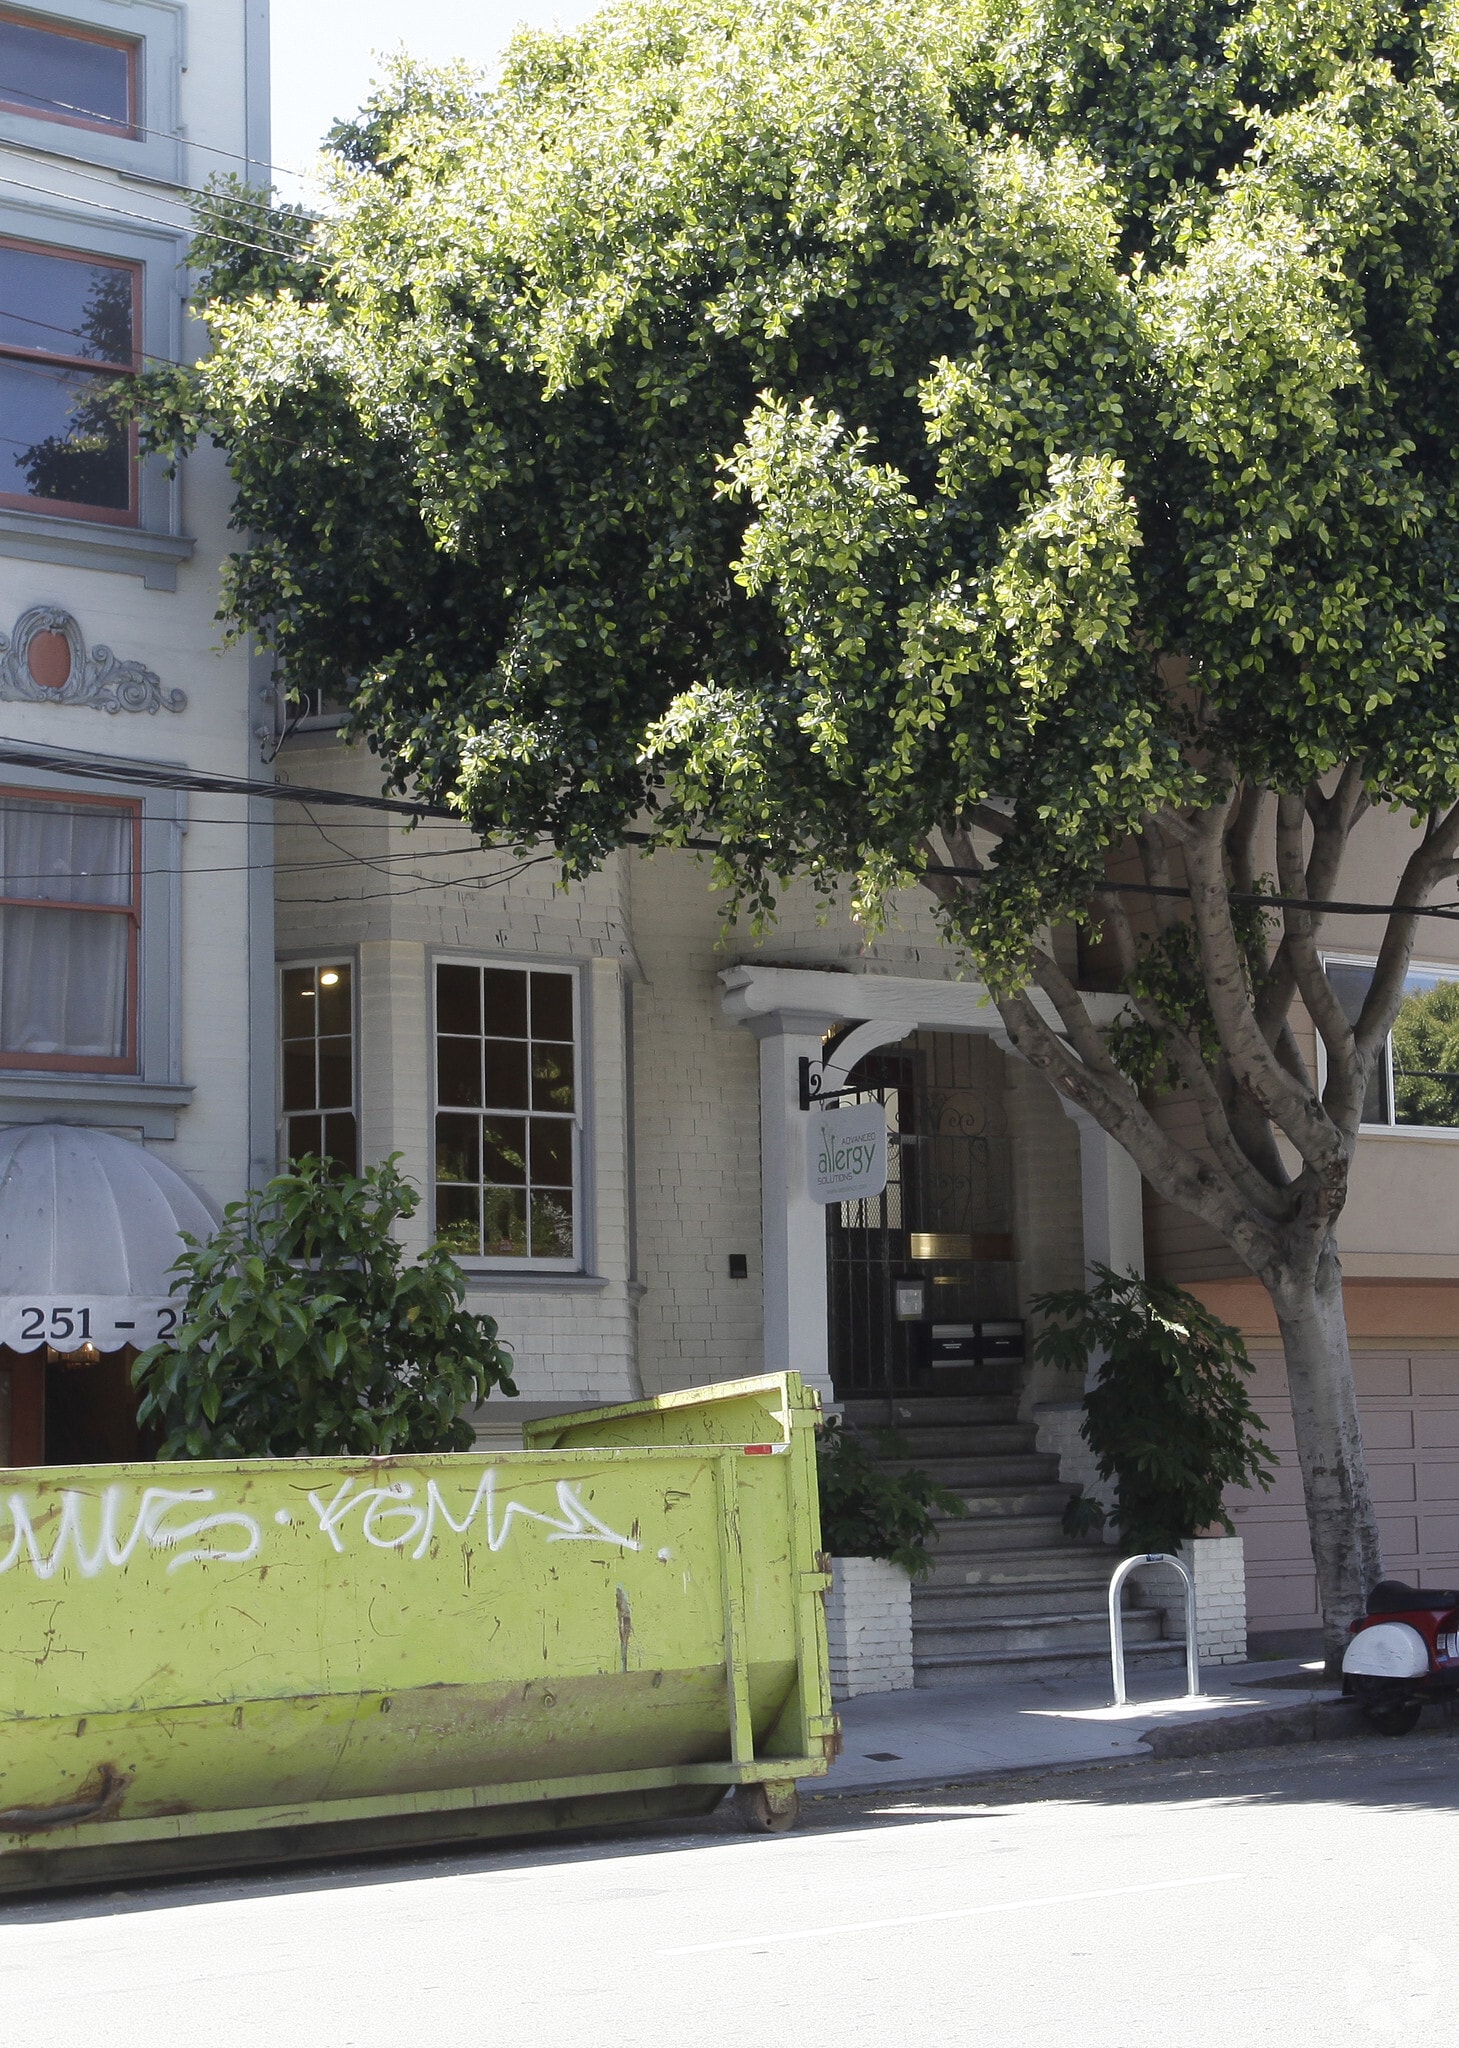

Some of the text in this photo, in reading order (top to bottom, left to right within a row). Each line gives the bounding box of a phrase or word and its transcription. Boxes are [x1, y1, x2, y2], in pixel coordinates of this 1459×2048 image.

[841, 1132, 876, 1145] ADVANCED
[818, 1127, 876, 1175] allergy
[817, 1172, 853, 1185] SOLUTIONS
[21, 1307, 93, 1339] 251
